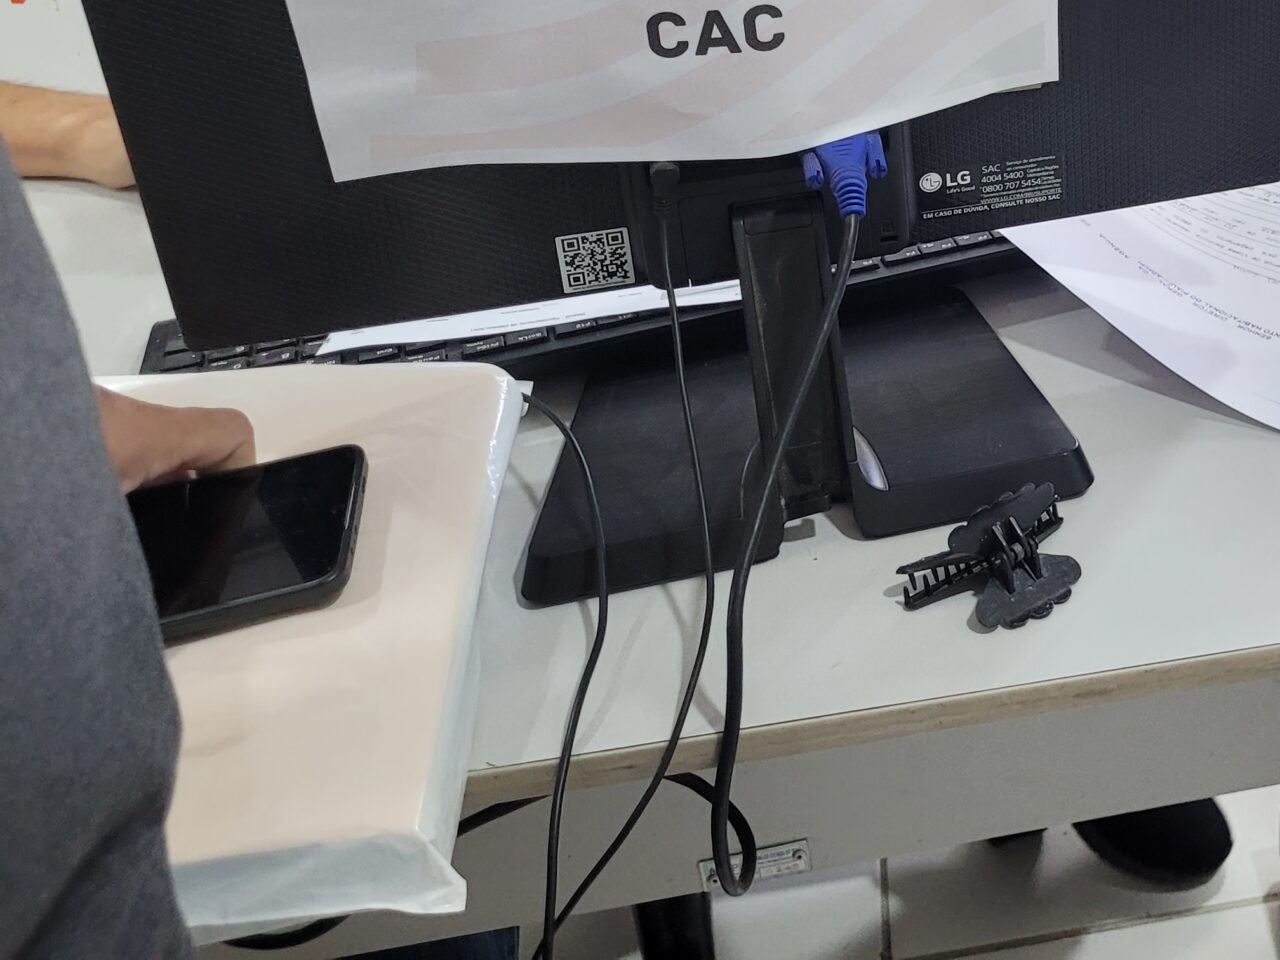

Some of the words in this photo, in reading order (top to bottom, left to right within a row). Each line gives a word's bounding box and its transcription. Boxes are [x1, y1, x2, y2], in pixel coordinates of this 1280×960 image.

[646, 4, 785, 58] CAC
[980, 174, 1002, 183] 4004
[1003, 170, 1024, 180] 5400
[981, 164, 1000, 174] SAC
[946, 170, 971, 187] LG
[1004, 180, 1020, 190] 707
[1021, 178, 1040, 188] 5454
[934, 210, 952, 218] CASO
[990, 200, 1024, 210] CONSULTE
[1024, 196, 1046, 204] NOSSO
[1192, 302, 1228, 322] DIRETOR
[1204, 302, 1262, 330] HABITACIONAL
[1237, 324, 1272, 340] SENHOR
